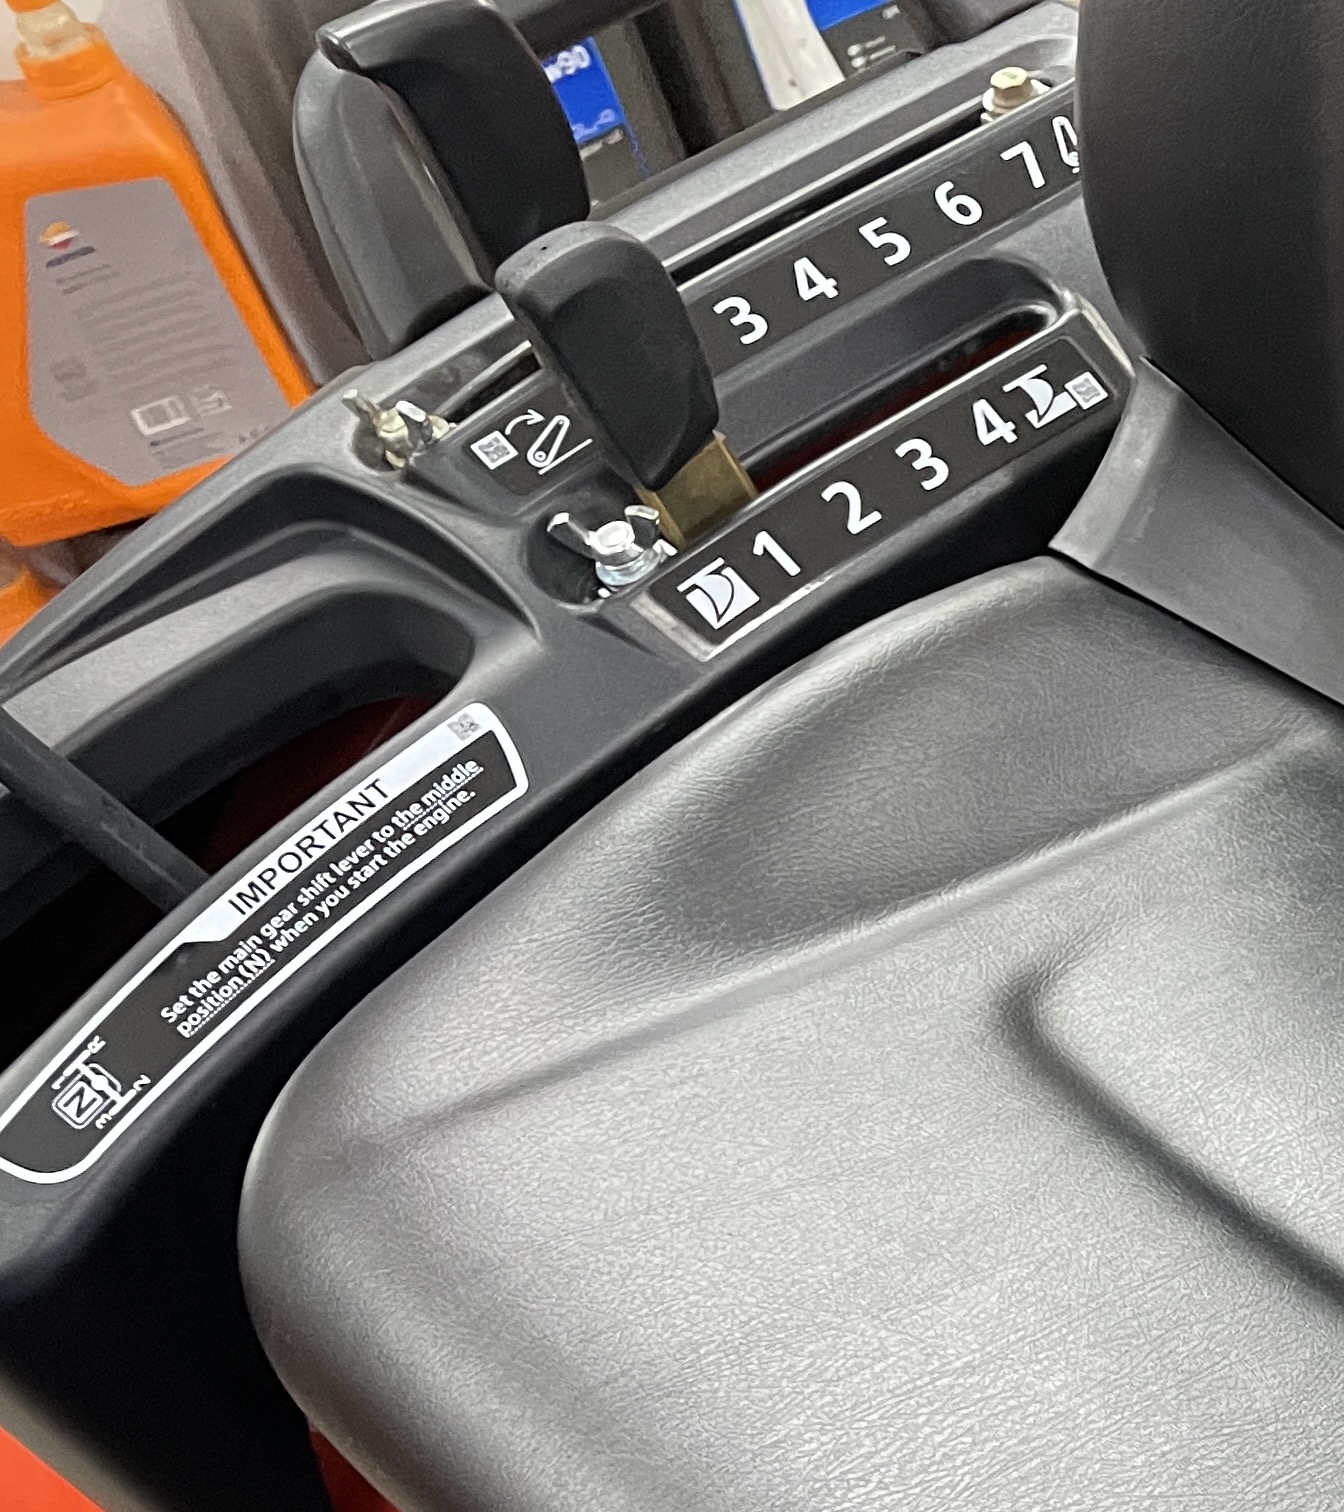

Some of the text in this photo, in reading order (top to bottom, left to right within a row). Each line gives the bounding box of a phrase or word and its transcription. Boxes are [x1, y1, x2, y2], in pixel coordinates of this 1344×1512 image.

[713, 141, 1046, 345] 3 4 5 6 7
[752, 398, 1018, 577] 1 2 3 4
[160, 760, 479, 1023] Set the main gear shift lever to the middle
[176, 789, 476, 1039] position (N) when you start the engine.
[228, 778, 388, 915] IMPORTANT
[62, 1086, 98, 1118] N
